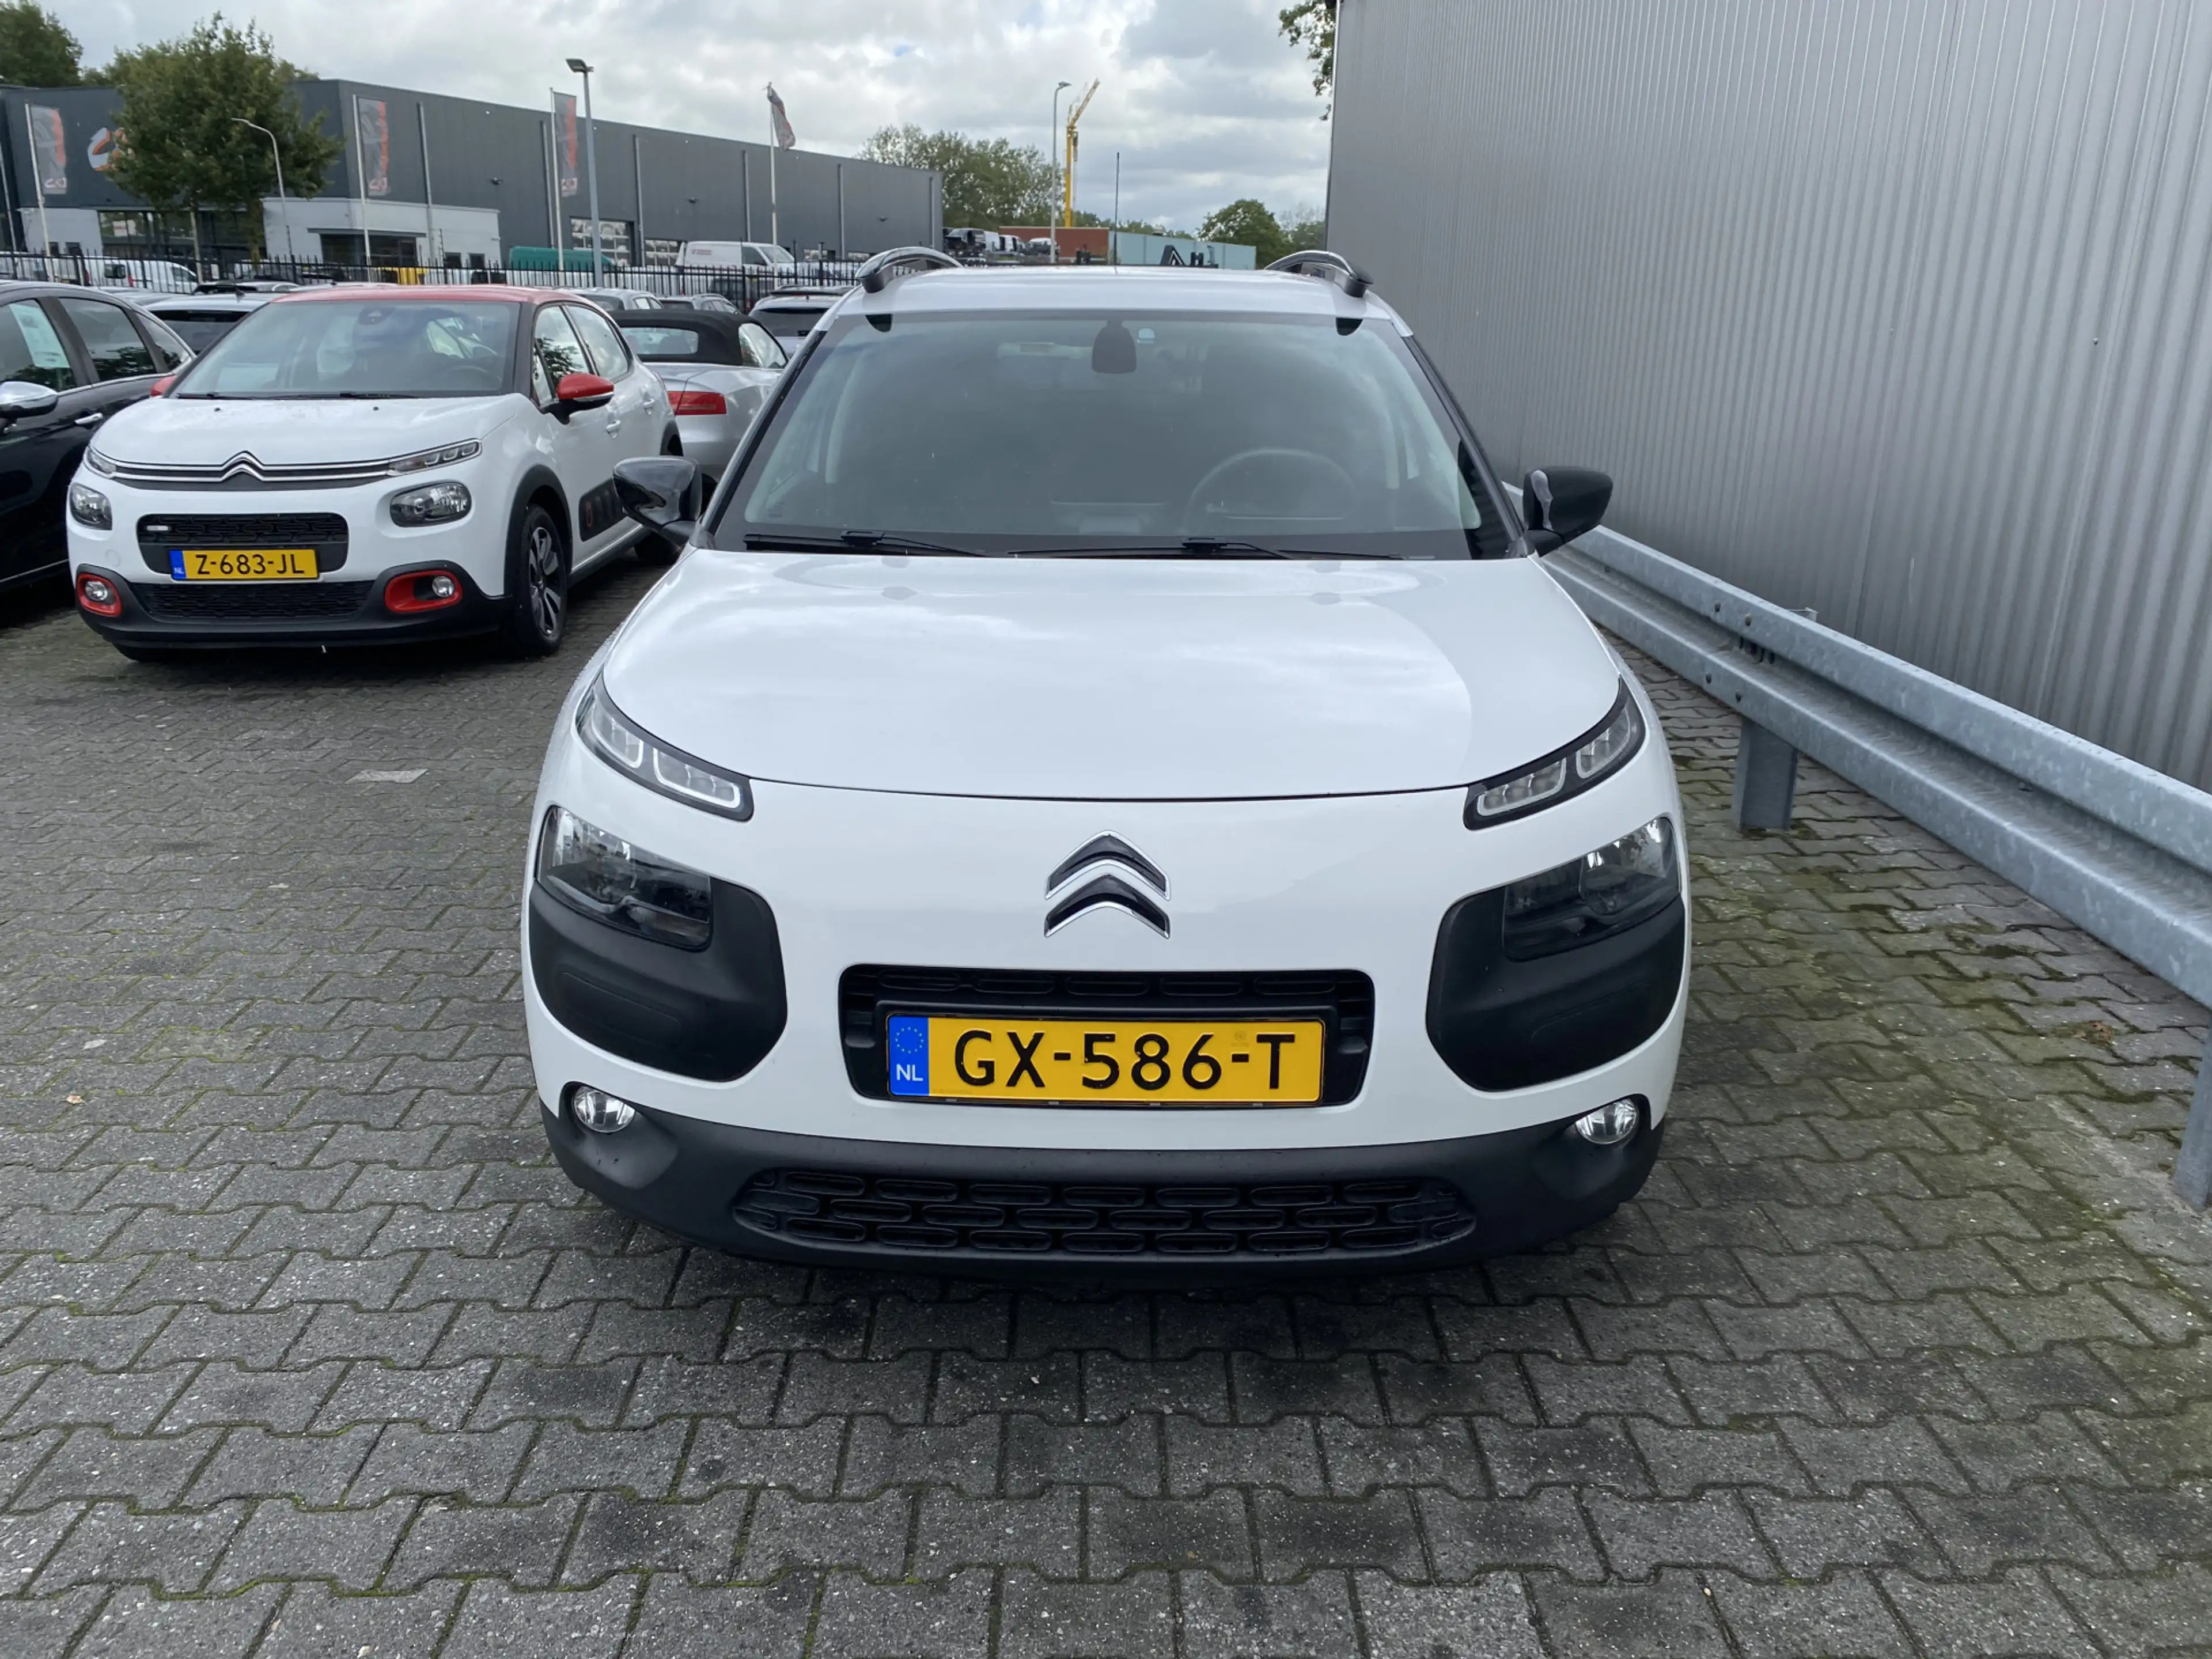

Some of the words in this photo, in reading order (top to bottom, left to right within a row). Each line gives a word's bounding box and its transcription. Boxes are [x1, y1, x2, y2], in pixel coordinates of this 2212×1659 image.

[195, 554, 305, 575] Z-683-JL
[955, 1029, 1296, 1090] GX-586-T
[896, 1063, 923, 1082] NL
